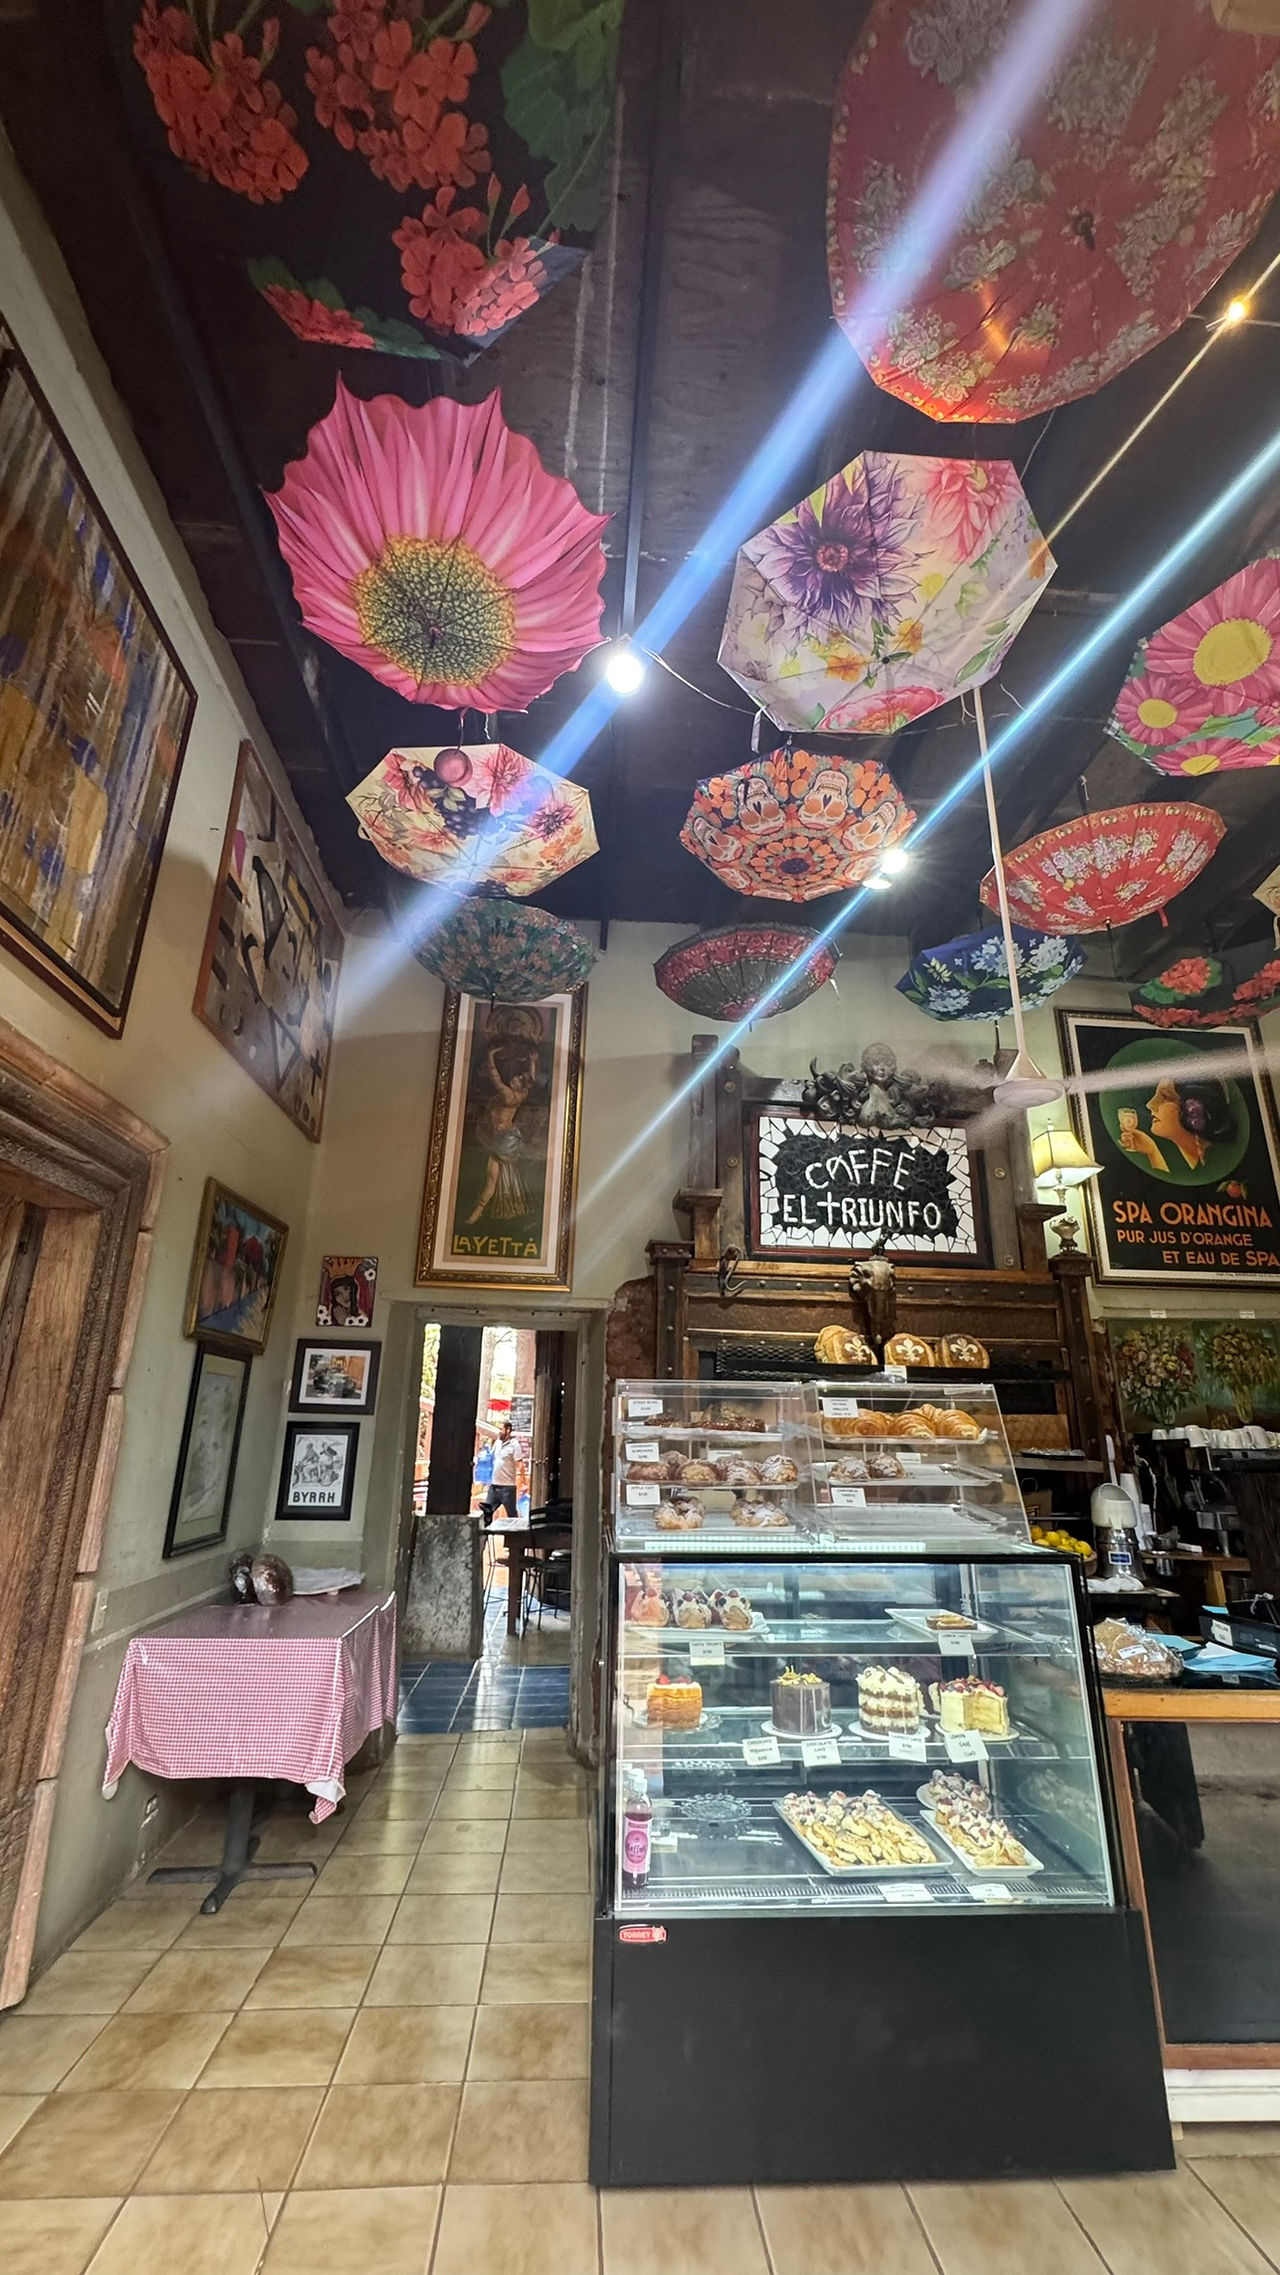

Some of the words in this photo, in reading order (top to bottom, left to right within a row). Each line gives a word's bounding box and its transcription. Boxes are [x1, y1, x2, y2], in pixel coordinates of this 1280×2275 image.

[783, 1194, 816, 1225] EL
[817, 1191, 941, 1230] TRIUNFO
[1112, 1200, 1153, 1224] SPA
[1160, 1202, 1273, 1228] ORANGINA
[1116, 1229, 1145, 1243] PUR
[1149, 1231, 1176, 1244] JUS
[1180, 1231, 1254, 1246] D'ORANGE
[1162, 1250, 1180, 1264] ET
[1186, 1251, 1215, 1265] EAU
[1220, 1252, 1240, 1266] DE
[1245, 1251, 1280, 1267] SPA
[292, 1491, 336, 1504] BYRRH
